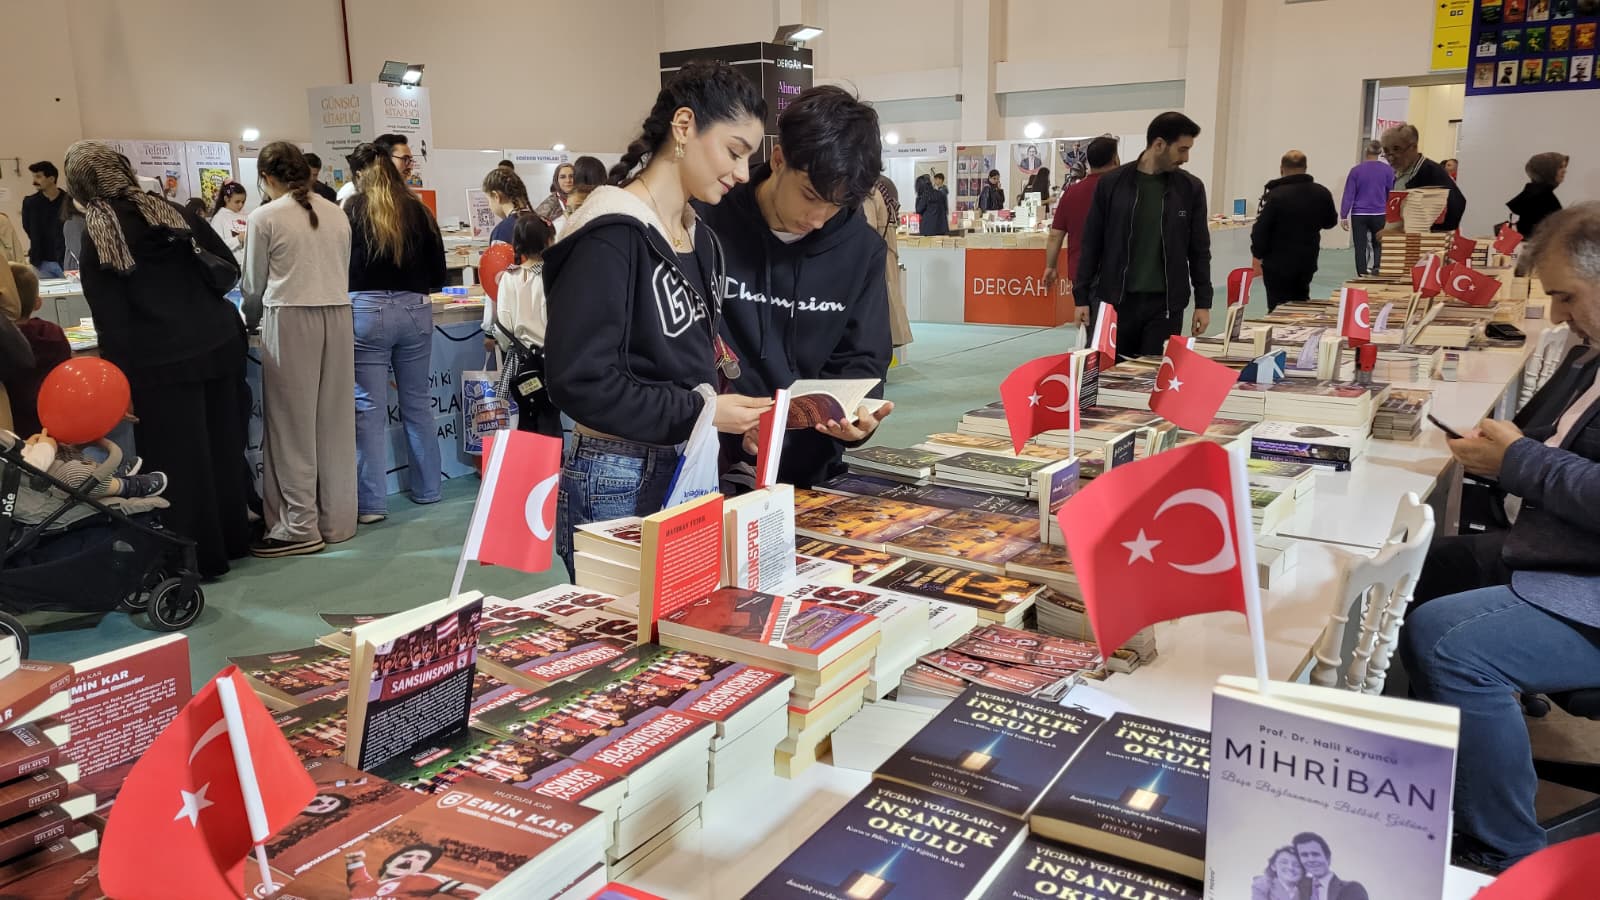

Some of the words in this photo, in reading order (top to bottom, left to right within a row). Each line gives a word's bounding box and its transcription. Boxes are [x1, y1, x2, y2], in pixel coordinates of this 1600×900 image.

[778, 81, 801, 94] Ahmet
[973, 275, 1048, 297] DERGÂH
[437, 419, 458, 440] AR!
[2, 493, 16, 518] Joie
[71, 679, 97, 696] MİN
[101, 670, 130, 686] KAR
[391, 662, 454, 694] SAMSUNSPOR
[690, 668, 765, 714] SAMSUNSPOR
[965, 697, 1083, 734] İNSANLIK
[971, 711, 1057, 740] OKULU
[594, 714, 683, 765] SAMSUNSPOR
[1114, 727, 1211, 758] İNSANL
[1259, 724, 1287, 739] Prof.
[1292, 733, 1308, 744] Dr.
[1313, 738, 1341, 752] Halil
[535, 768, 593, 797] SAMSU
[556, 774, 604, 801] KUZEYİ
[1224, 737, 1436, 812] MİHRİBAN
[466, 797, 523, 818] EMİN
[525, 814, 574, 834] KAR
[864, 797, 999, 848] İNSANLIK
[867, 816, 968, 855] OKULU
